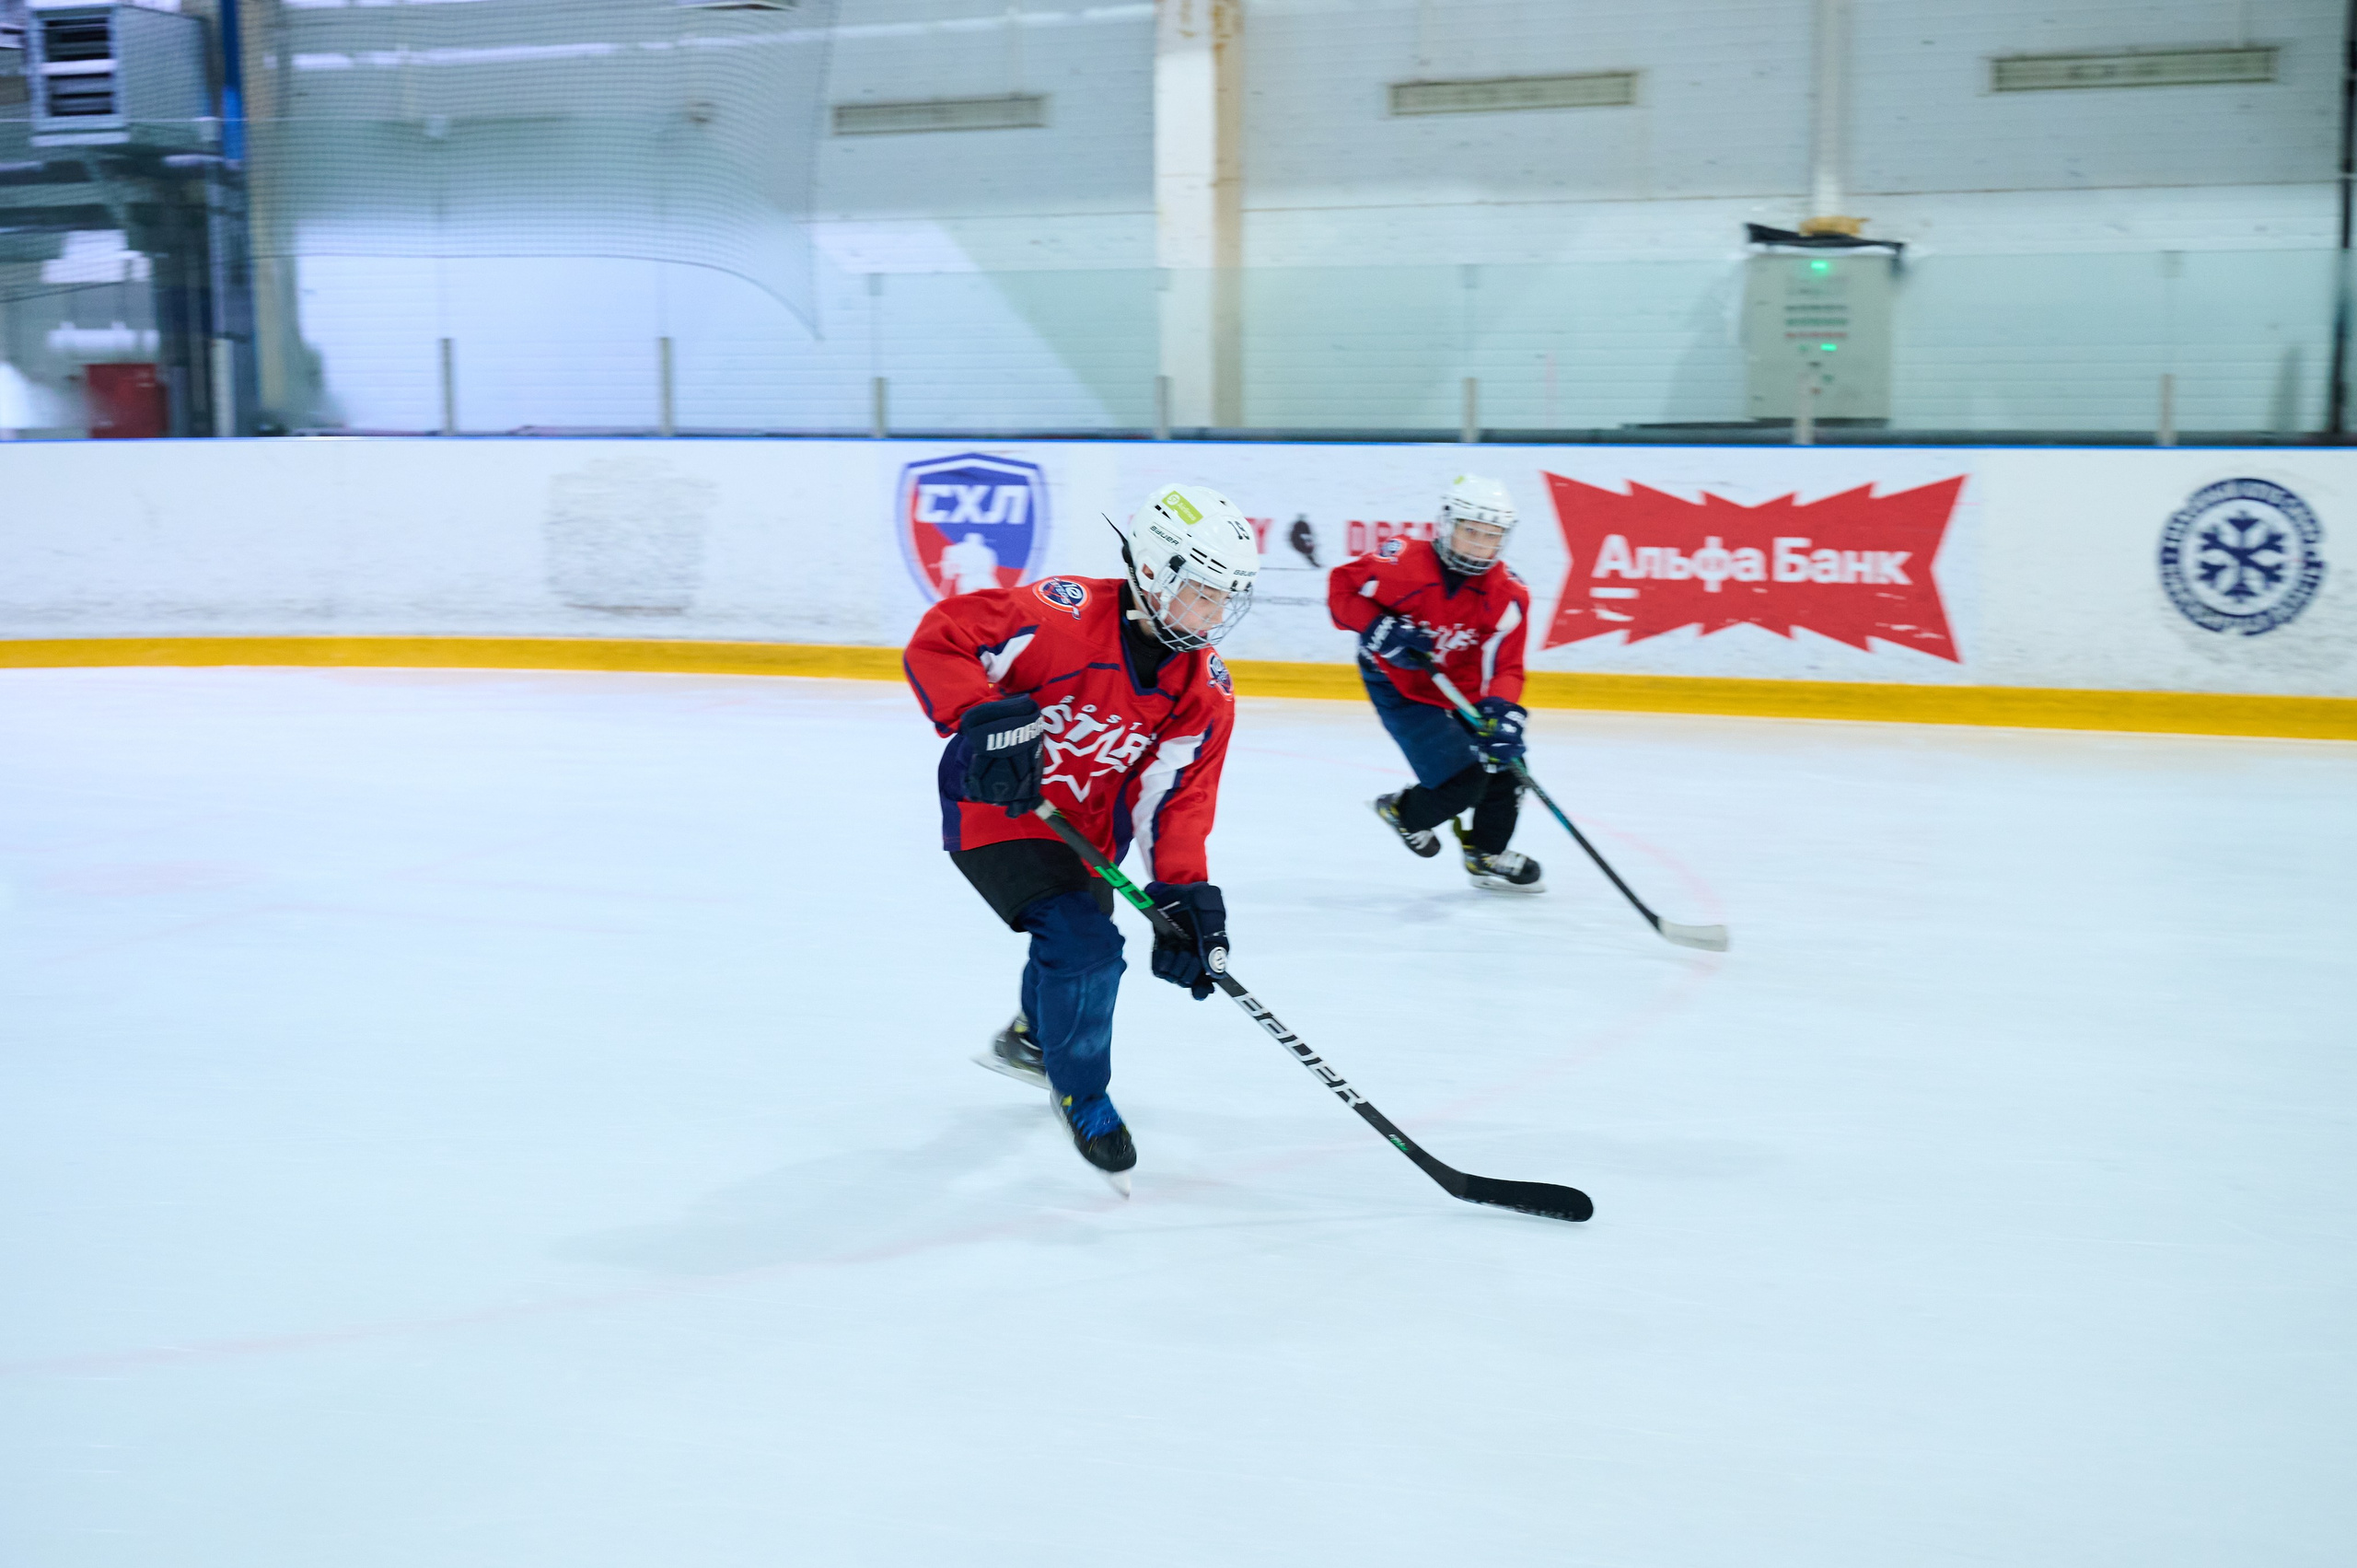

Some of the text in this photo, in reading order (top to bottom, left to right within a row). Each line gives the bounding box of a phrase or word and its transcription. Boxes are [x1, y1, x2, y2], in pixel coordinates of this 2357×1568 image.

[915, 483, 1030, 525] СХЛ
[1150, 525, 1179, 546] BAUER
[1591, 534, 1913, 593] Альфа Банк
[1233, 993, 1369, 1109] BAUER
